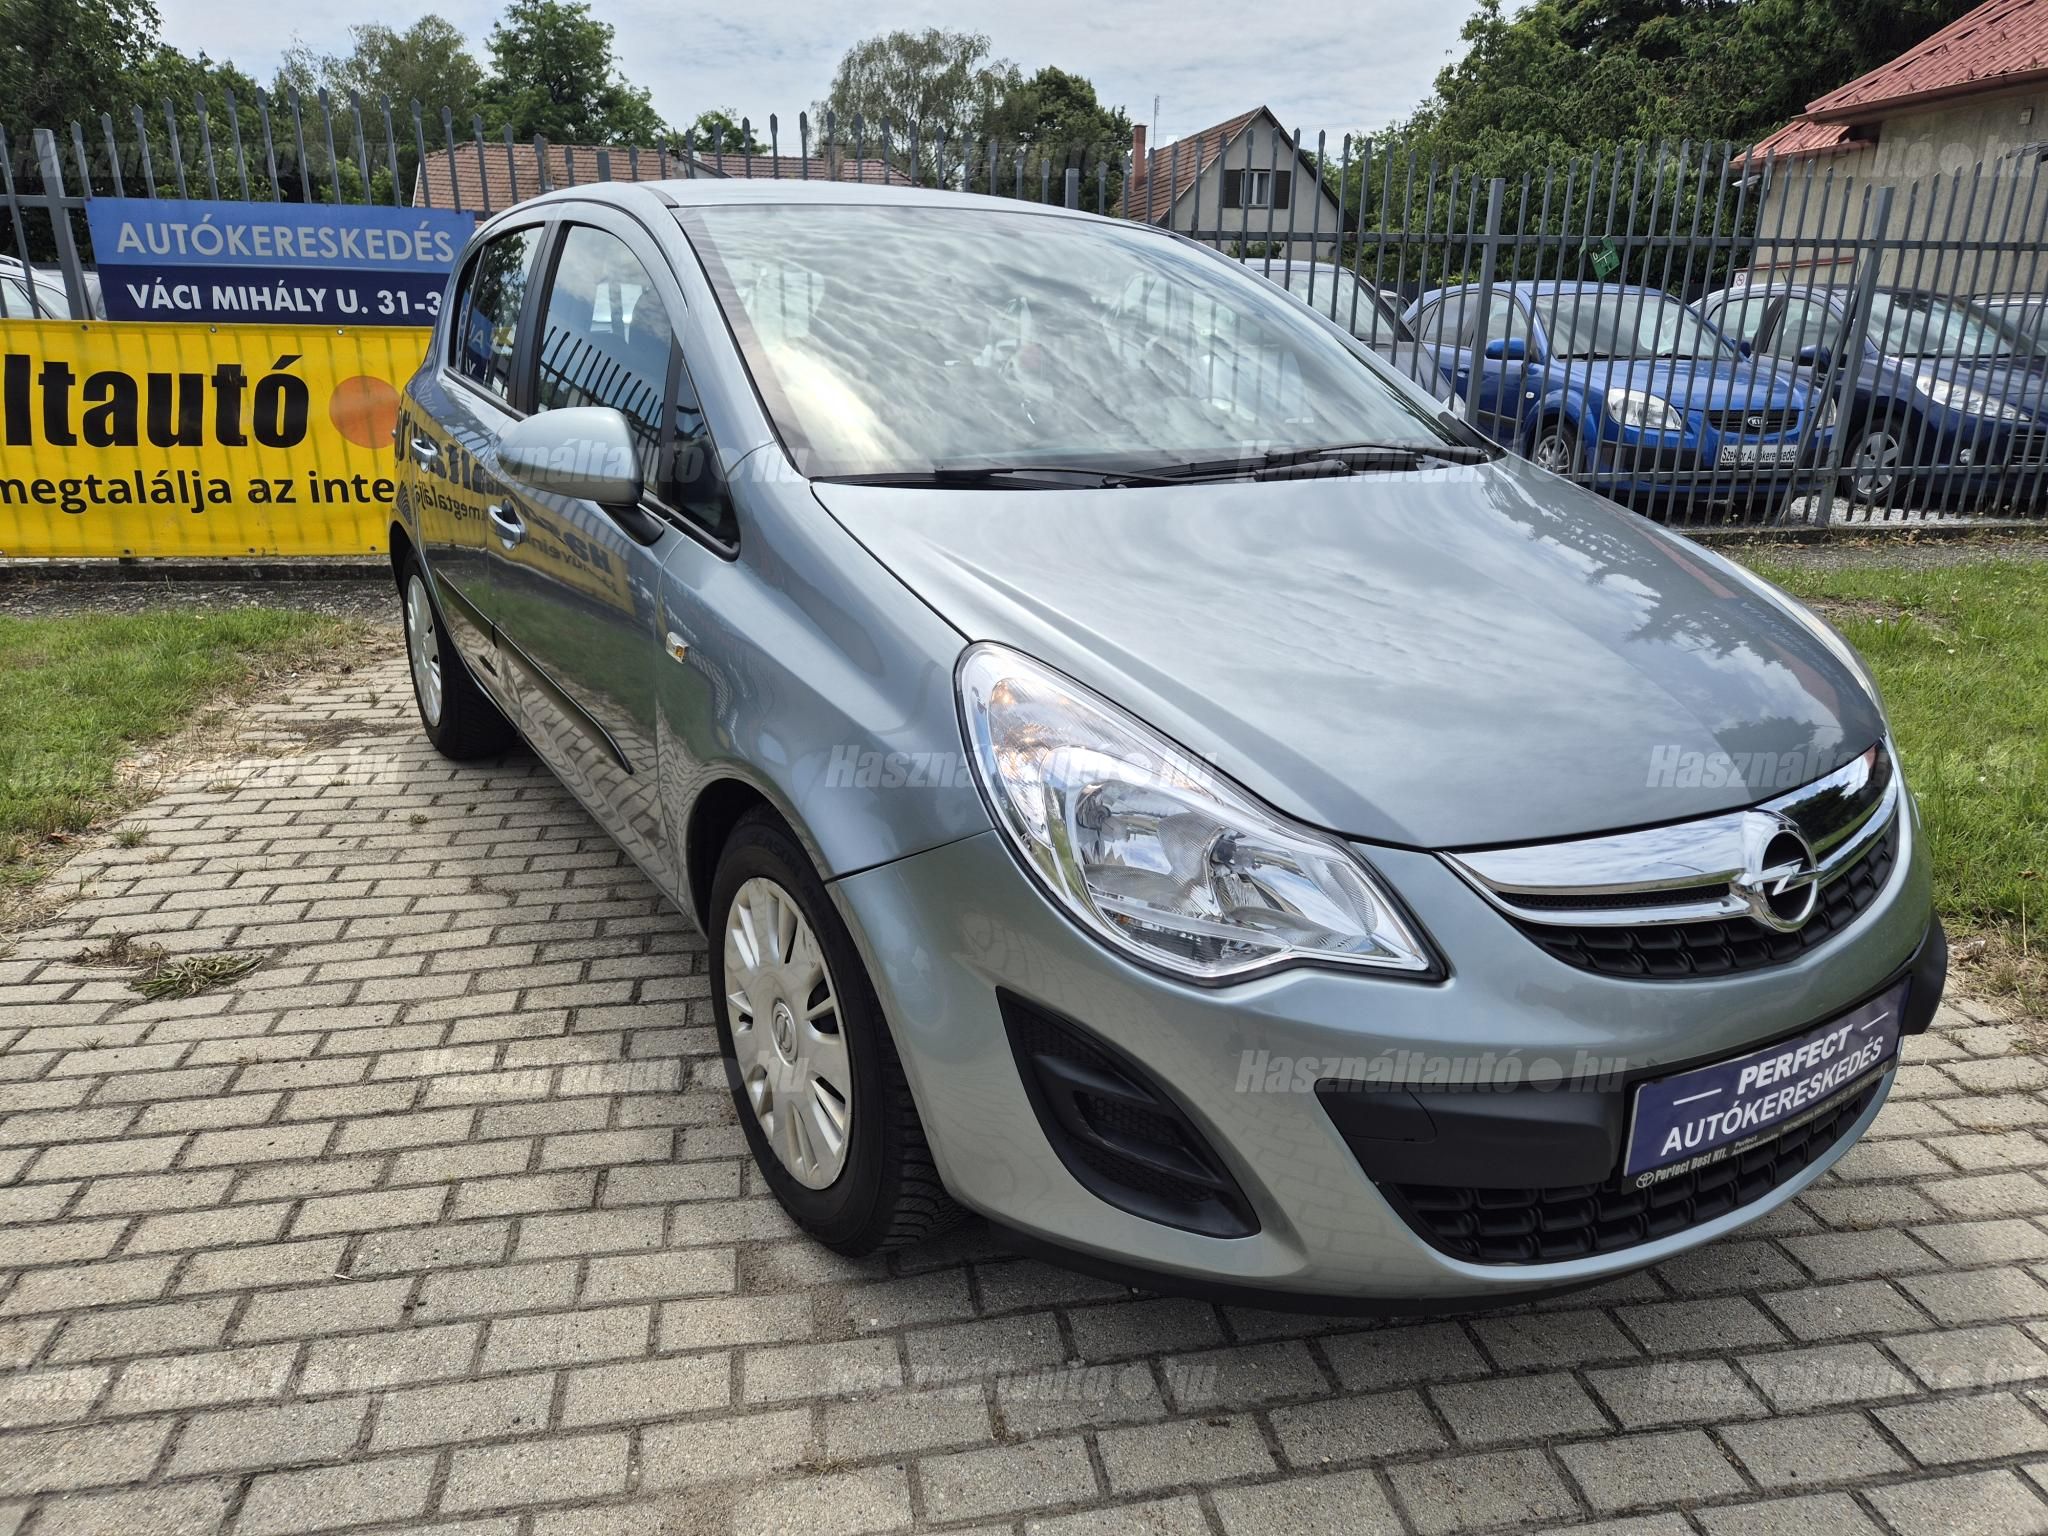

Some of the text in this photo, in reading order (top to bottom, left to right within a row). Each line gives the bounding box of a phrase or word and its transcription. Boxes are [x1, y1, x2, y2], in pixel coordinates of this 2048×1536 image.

[117, 213, 454, 262] AUTÓKERESKEDÉS
[126, 277, 201, 310] VÁCI
[213, 279, 327, 312] MIHÁLY
[336, 288, 368, 314] U.
[0, 469, 394, 515] megtalálja az inte
[1737, 1024, 1854, 1095] PERFECT
[1661, 1035, 1884, 1156] AUTÓKERESKEDÉS
[1655, 1160, 1690, 1182] Perfect
[1691, 1152, 1712, 1169] Best
